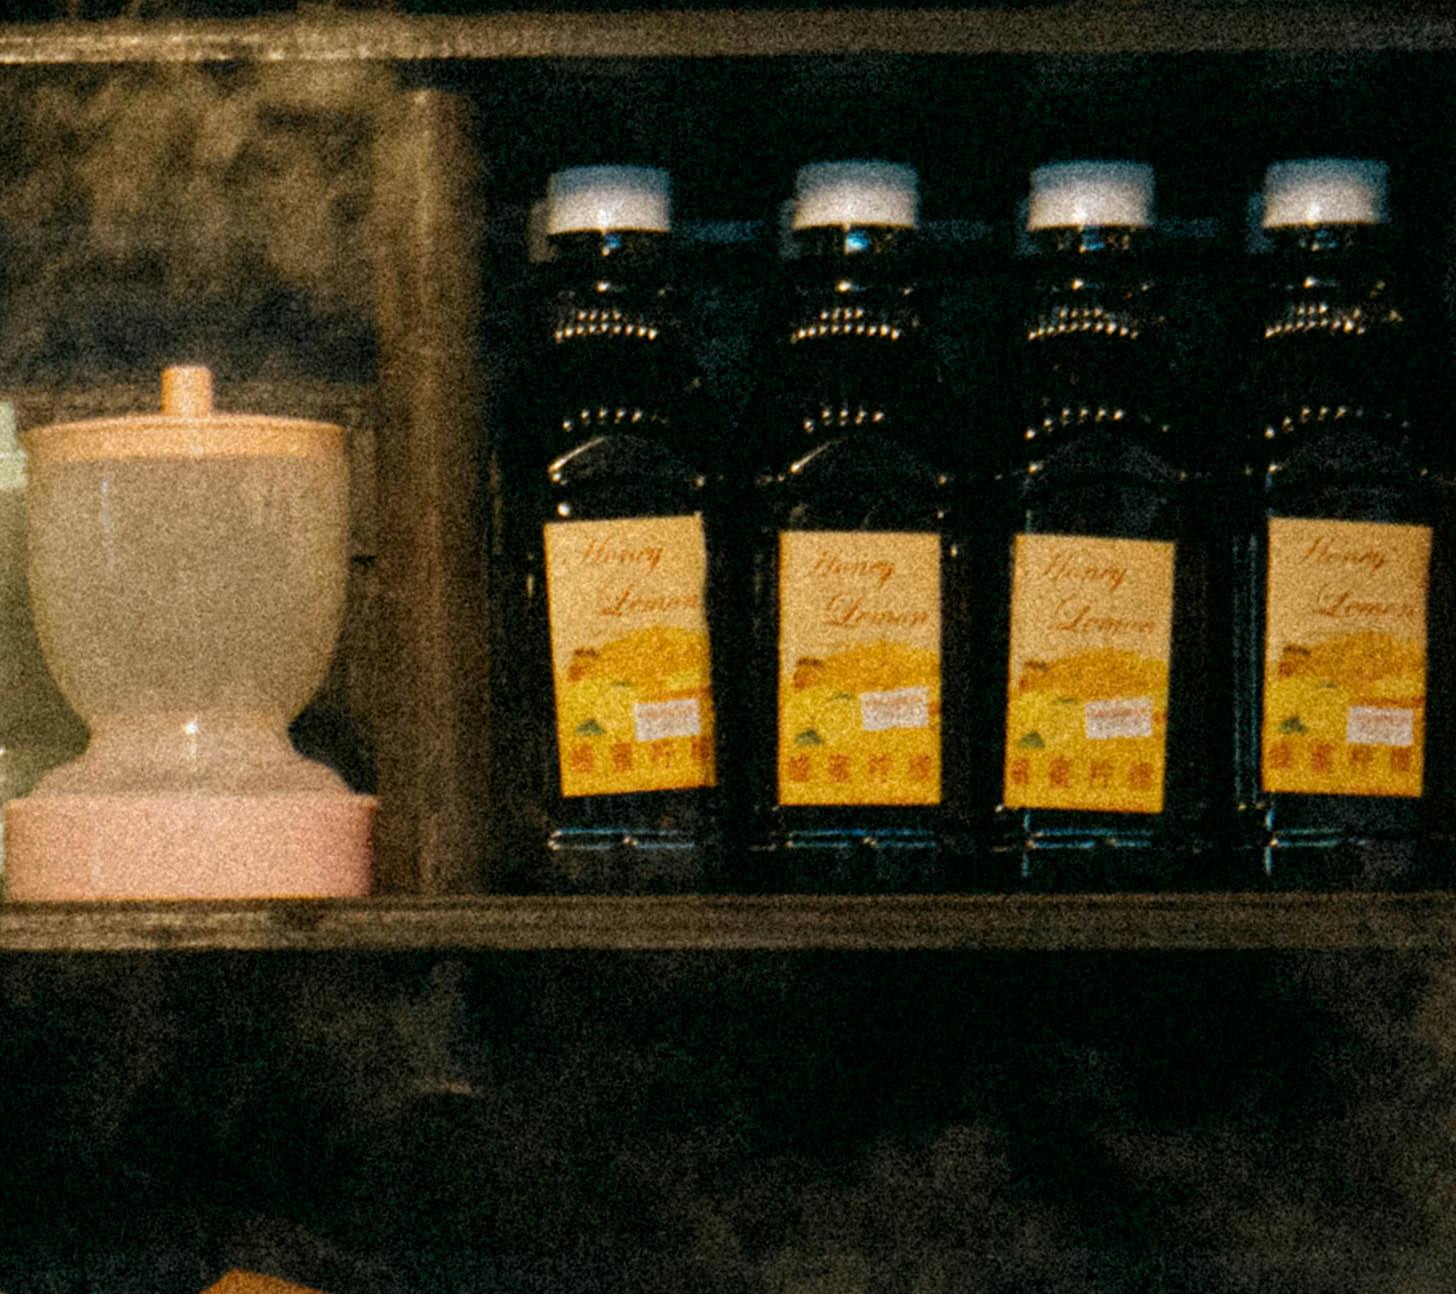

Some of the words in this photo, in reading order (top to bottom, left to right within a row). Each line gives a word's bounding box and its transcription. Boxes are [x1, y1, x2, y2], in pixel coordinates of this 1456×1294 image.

[580, 537, 664, 576] Honey
[811, 551, 895, 586] Honey
[1301, 536, 1385, 571] Honey
[1042, 551, 1129, 594] Honey
[824, 594, 931, 629] Lemon
[1054, 599, 1156, 632] Lemon
